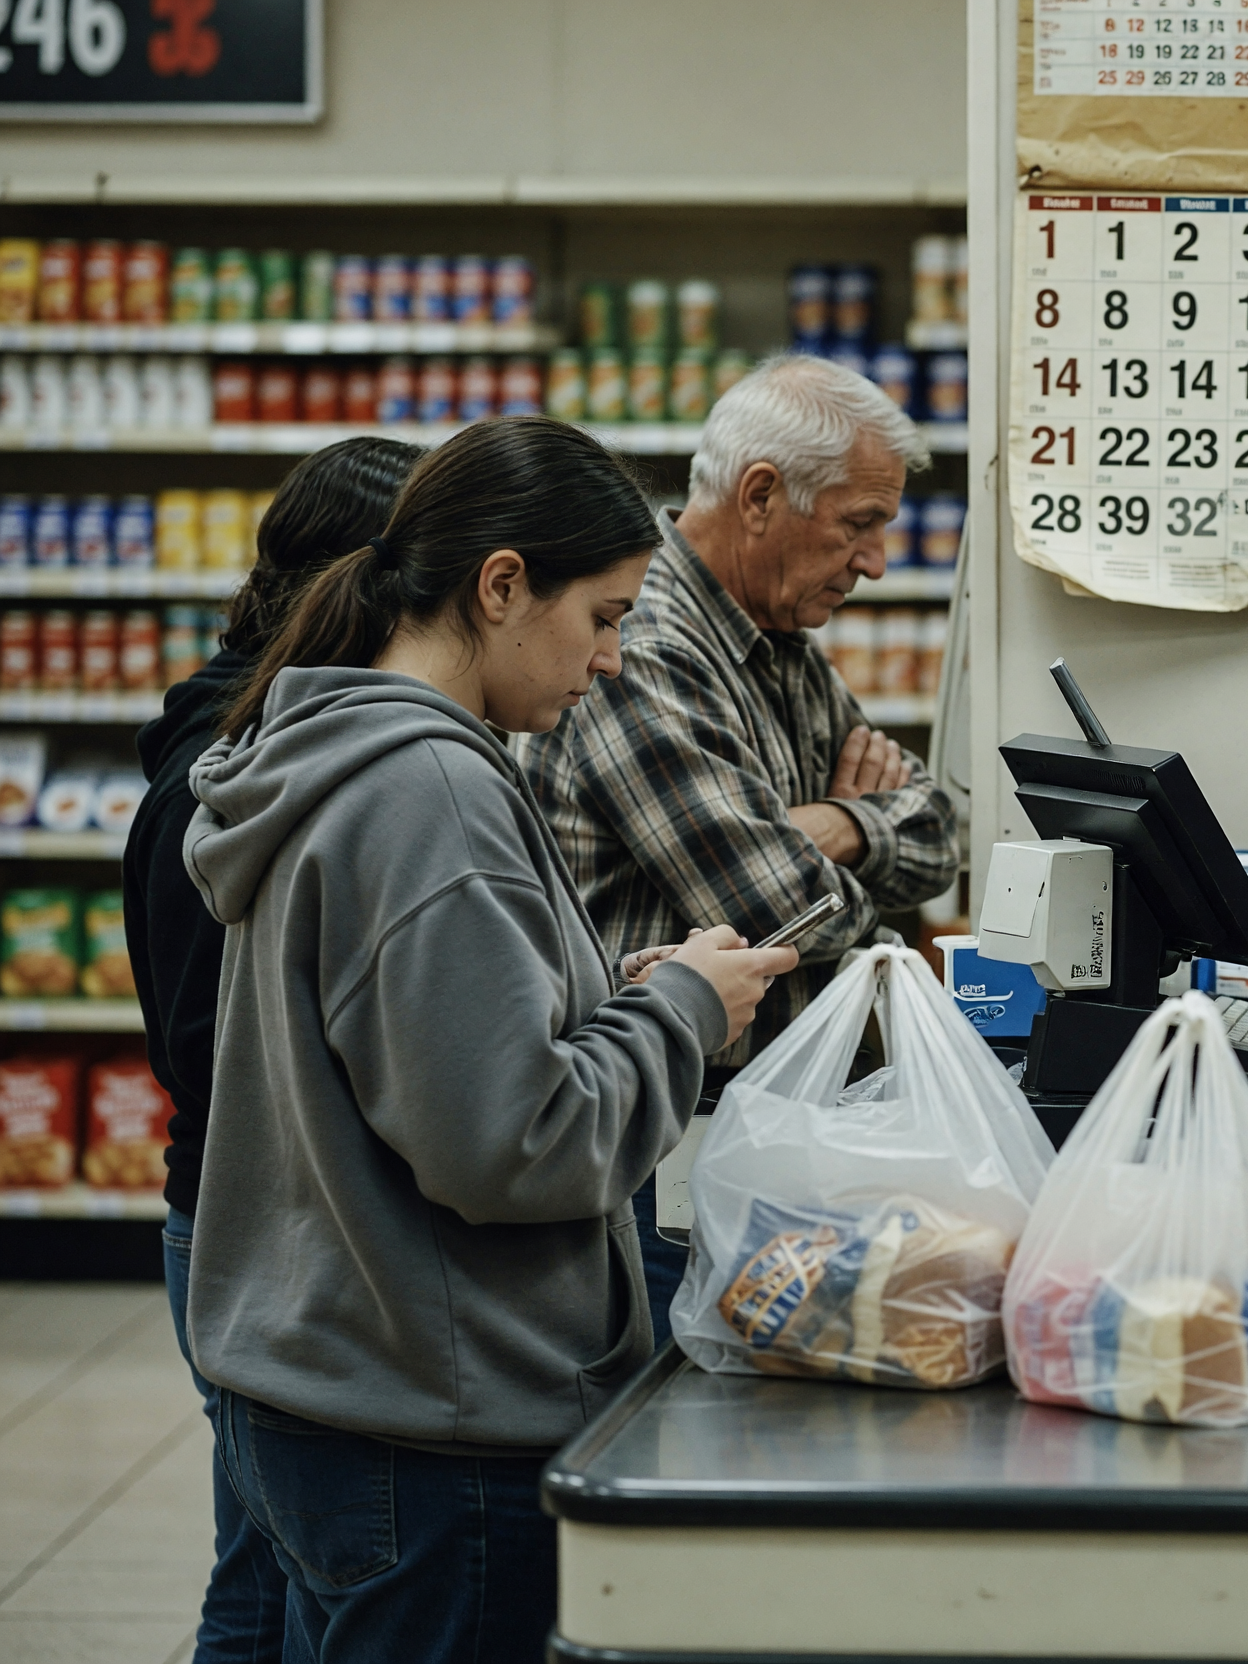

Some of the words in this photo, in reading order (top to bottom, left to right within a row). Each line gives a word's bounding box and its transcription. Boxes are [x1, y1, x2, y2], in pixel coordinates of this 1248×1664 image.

[0, 0, 127, 77] 46
[1207, 45, 1225, 60] 21
[1180, 71, 1198, 85] 27
[1207, 71, 1226, 86] 28
[1039, 220, 1055, 258] 1
[1107, 222, 1125, 260] 1
[1174, 222, 1198, 261] 2
[1035, 289, 1059, 328] 8
[1104, 290, 1128, 330] 8
[1173, 291, 1197, 330] 9
[1034, 358, 1081, 397] 14
[1102, 359, 1148, 398] 13
[1170, 360, 1217, 399] 14
[1031, 426, 1074, 465] 21
[1099, 427, 1149, 466] 22
[1167, 428, 1218, 468] 23
[1031, 494, 1081, 533] 28
[1099, 496, 1149, 535] 39
[1167, 496, 1218, 536] 32
